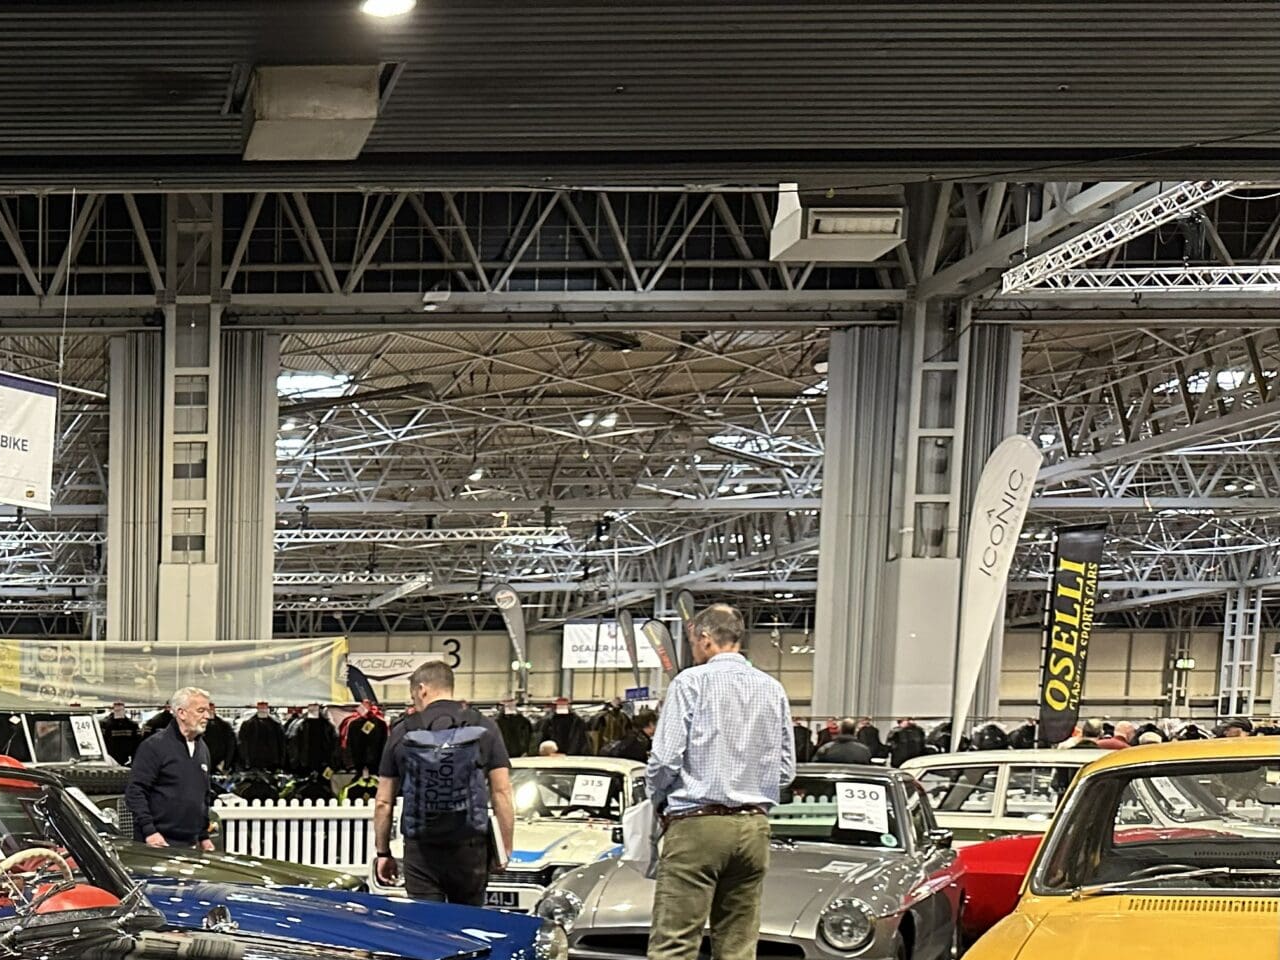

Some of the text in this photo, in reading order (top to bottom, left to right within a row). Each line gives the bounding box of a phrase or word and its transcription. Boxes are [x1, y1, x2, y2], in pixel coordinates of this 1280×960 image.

[979, 469, 1024, 577] ICONIC
[1085, 561, 1098, 597] CARS
[1045, 557, 1086, 712] OSELLI
[1080, 598, 1095, 647] SPORTS
[442, 638, 461, 669] 3
[424, 769, 438, 812] FACE
[438, 752, 454, 812] NORTH
[844, 788, 880, 801] 330
